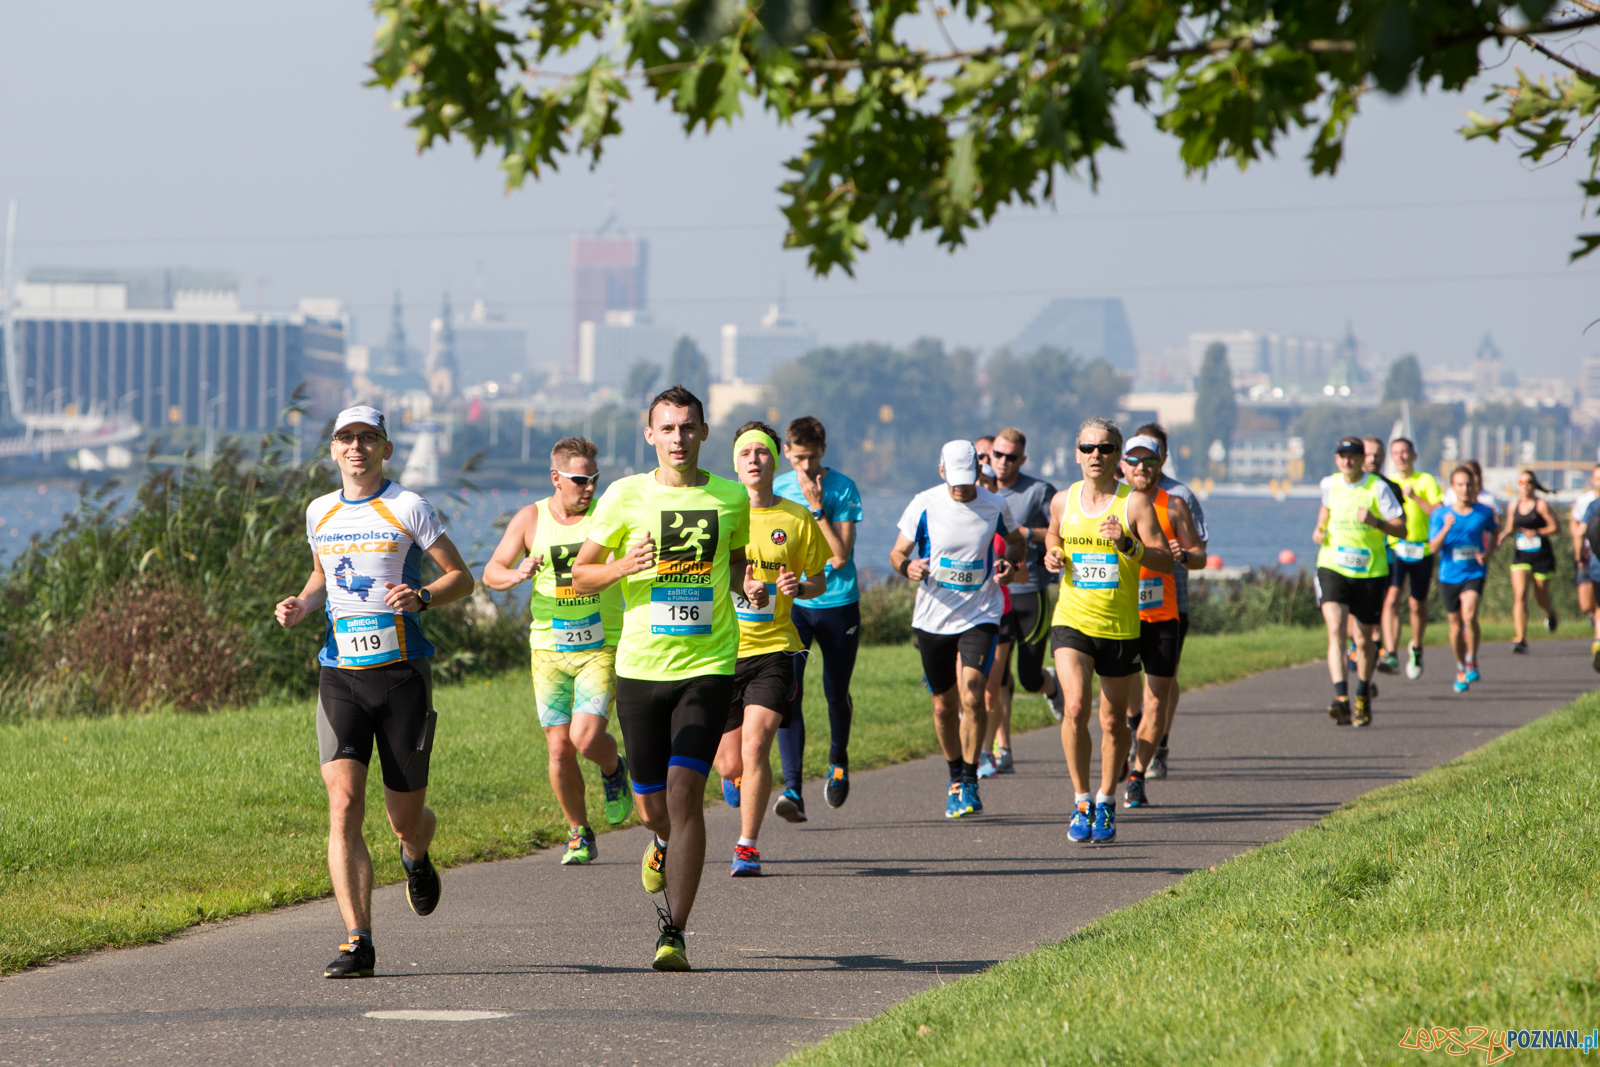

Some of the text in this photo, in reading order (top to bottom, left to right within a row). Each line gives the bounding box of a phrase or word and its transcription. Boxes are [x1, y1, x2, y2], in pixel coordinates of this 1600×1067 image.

[316, 531, 399, 543] Wielkopolscy
[1066, 535, 1114, 547] UBOŃ BIE
[669, 561, 704, 574] night
[1082, 567, 1106, 579] 376
[656, 573, 711, 584] runners
[950, 571, 973, 583] 288
[667, 588, 700, 597] zaBIEGaj
[556, 595, 600, 607] runners
[668, 605, 700, 621] 156
[347, 618, 378, 627] zaBIEGaj
[566, 630, 593, 643] 213
[351, 634, 381, 652] 119
